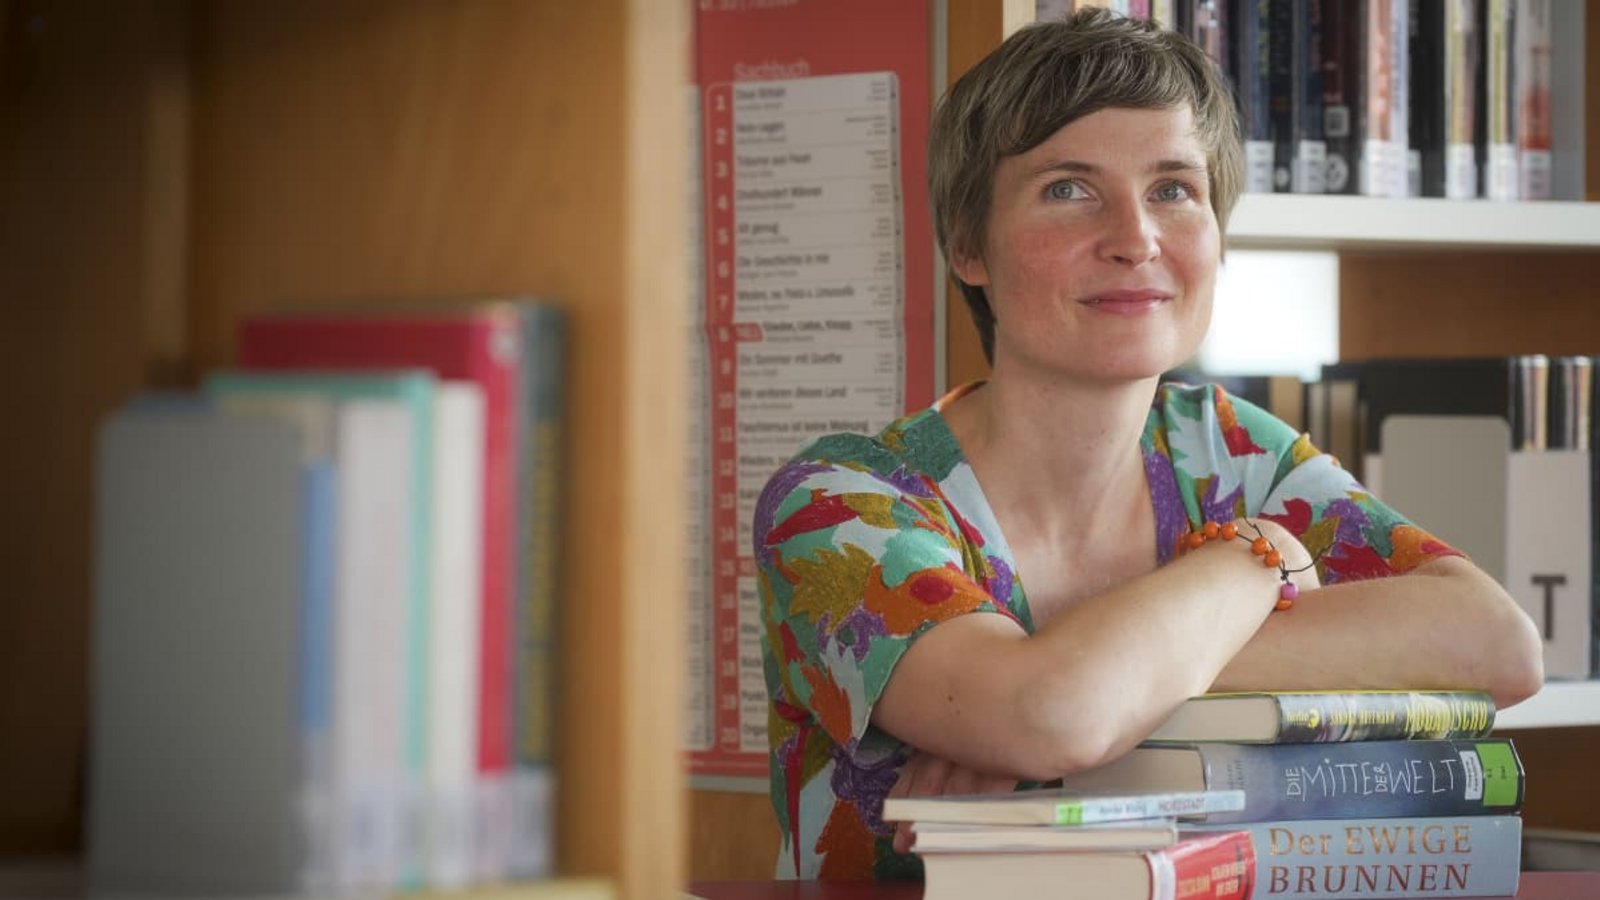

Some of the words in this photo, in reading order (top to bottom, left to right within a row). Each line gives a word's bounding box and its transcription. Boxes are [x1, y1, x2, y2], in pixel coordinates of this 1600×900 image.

[733, 60, 810, 78] Sachbuch
[716, 94, 726, 112] 1
[715, 127, 727, 146] 2
[715, 161, 728, 179] 3
[716, 194, 728, 211] 4
[716, 227, 728, 246] 5
[717, 260, 730, 279] 6
[718, 293, 728, 311] 7
[1531, 574, 1567, 641] T
[1285, 767, 1301, 796] DIE
[1373, 763, 1388, 793] DER
[1386, 757, 1457, 794] WELT
[1268, 827, 1333, 856] Der
[1344, 824, 1473, 855] EWIGE
[1267, 863, 1471, 894] BRUNNEN
